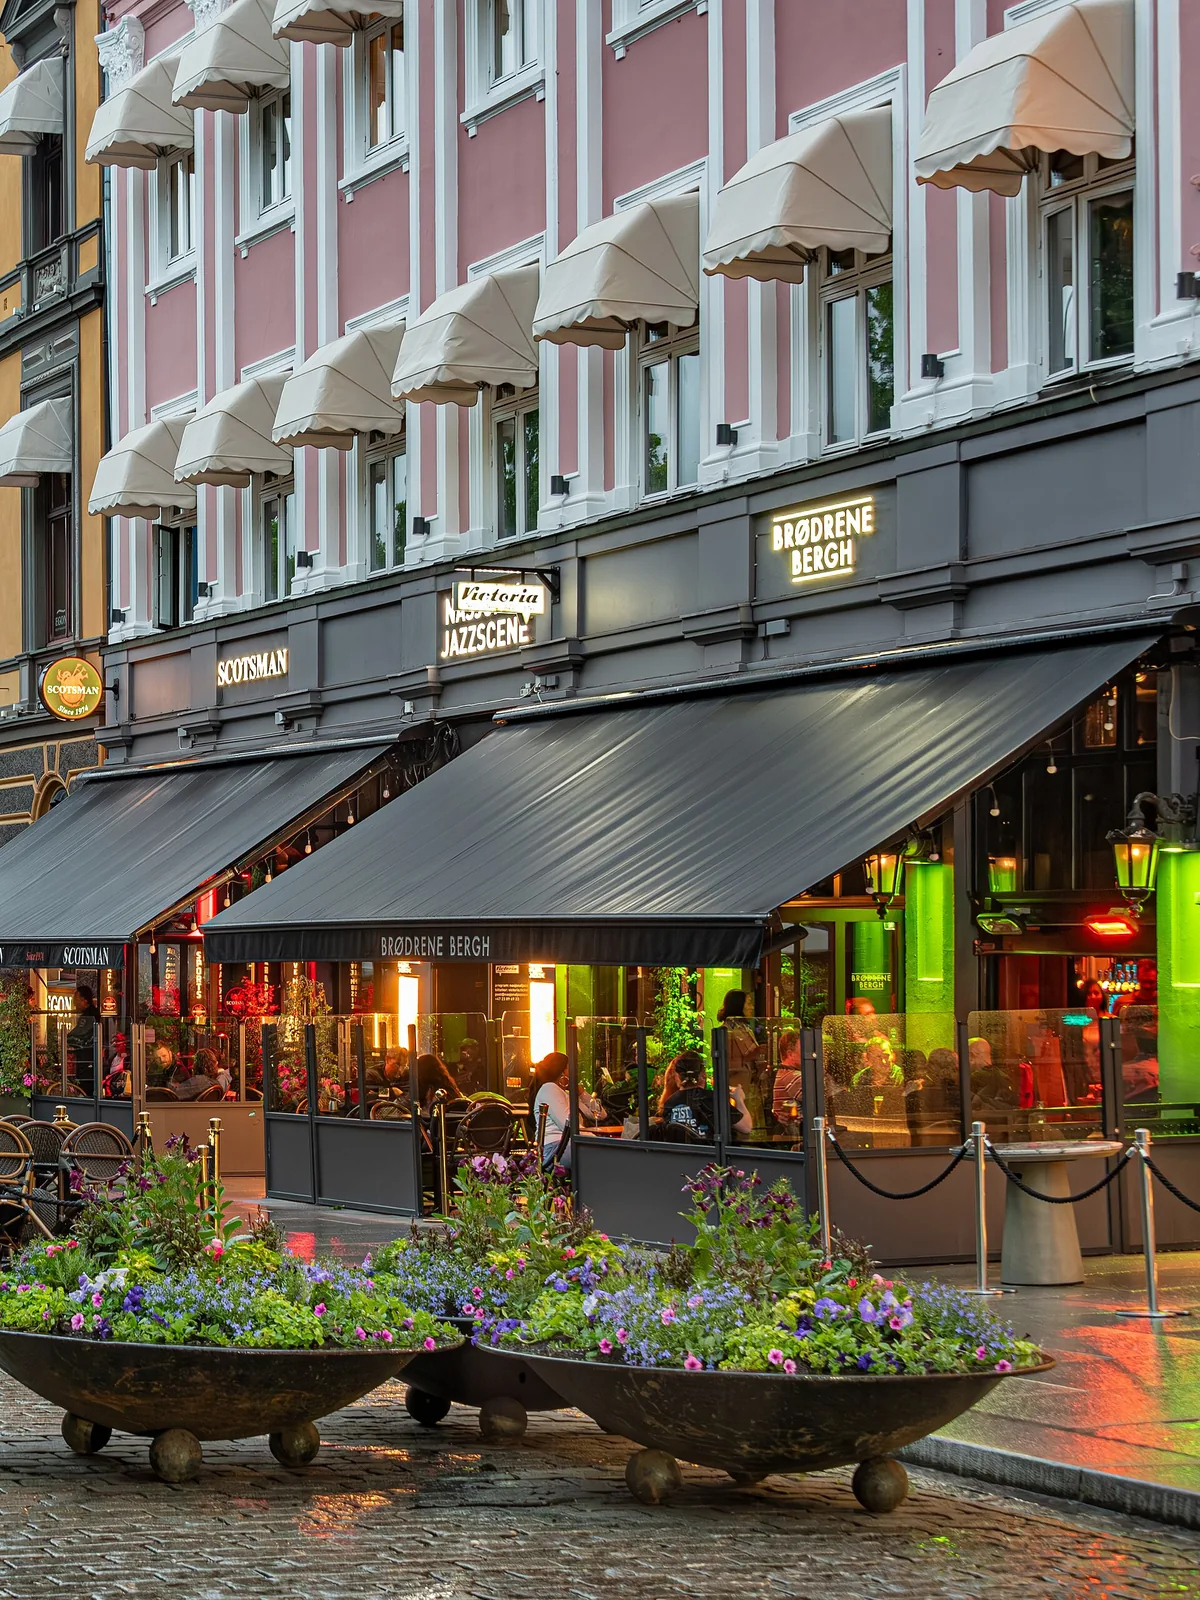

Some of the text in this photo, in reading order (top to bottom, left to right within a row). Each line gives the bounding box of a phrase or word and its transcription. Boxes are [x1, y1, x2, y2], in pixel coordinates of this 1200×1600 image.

[773, 505, 872, 551] BRØDRENE
[792, 539, 853, 576] BERGH
[462, 586, 538, 603] Victoria
[441, 615, 529, 658] JAZZSCENE
[218, 648, 288, 685] SCOTSMAN
[47, 685, 99, 695] SCOTSMAN
[58, 705, 74, 715] Since
[381, 935, 490, 956] BRØDRENE BERGH
[63, 947, 109, 965] SCOTSMAN
[672, 1106, 691, 1120] FIST
